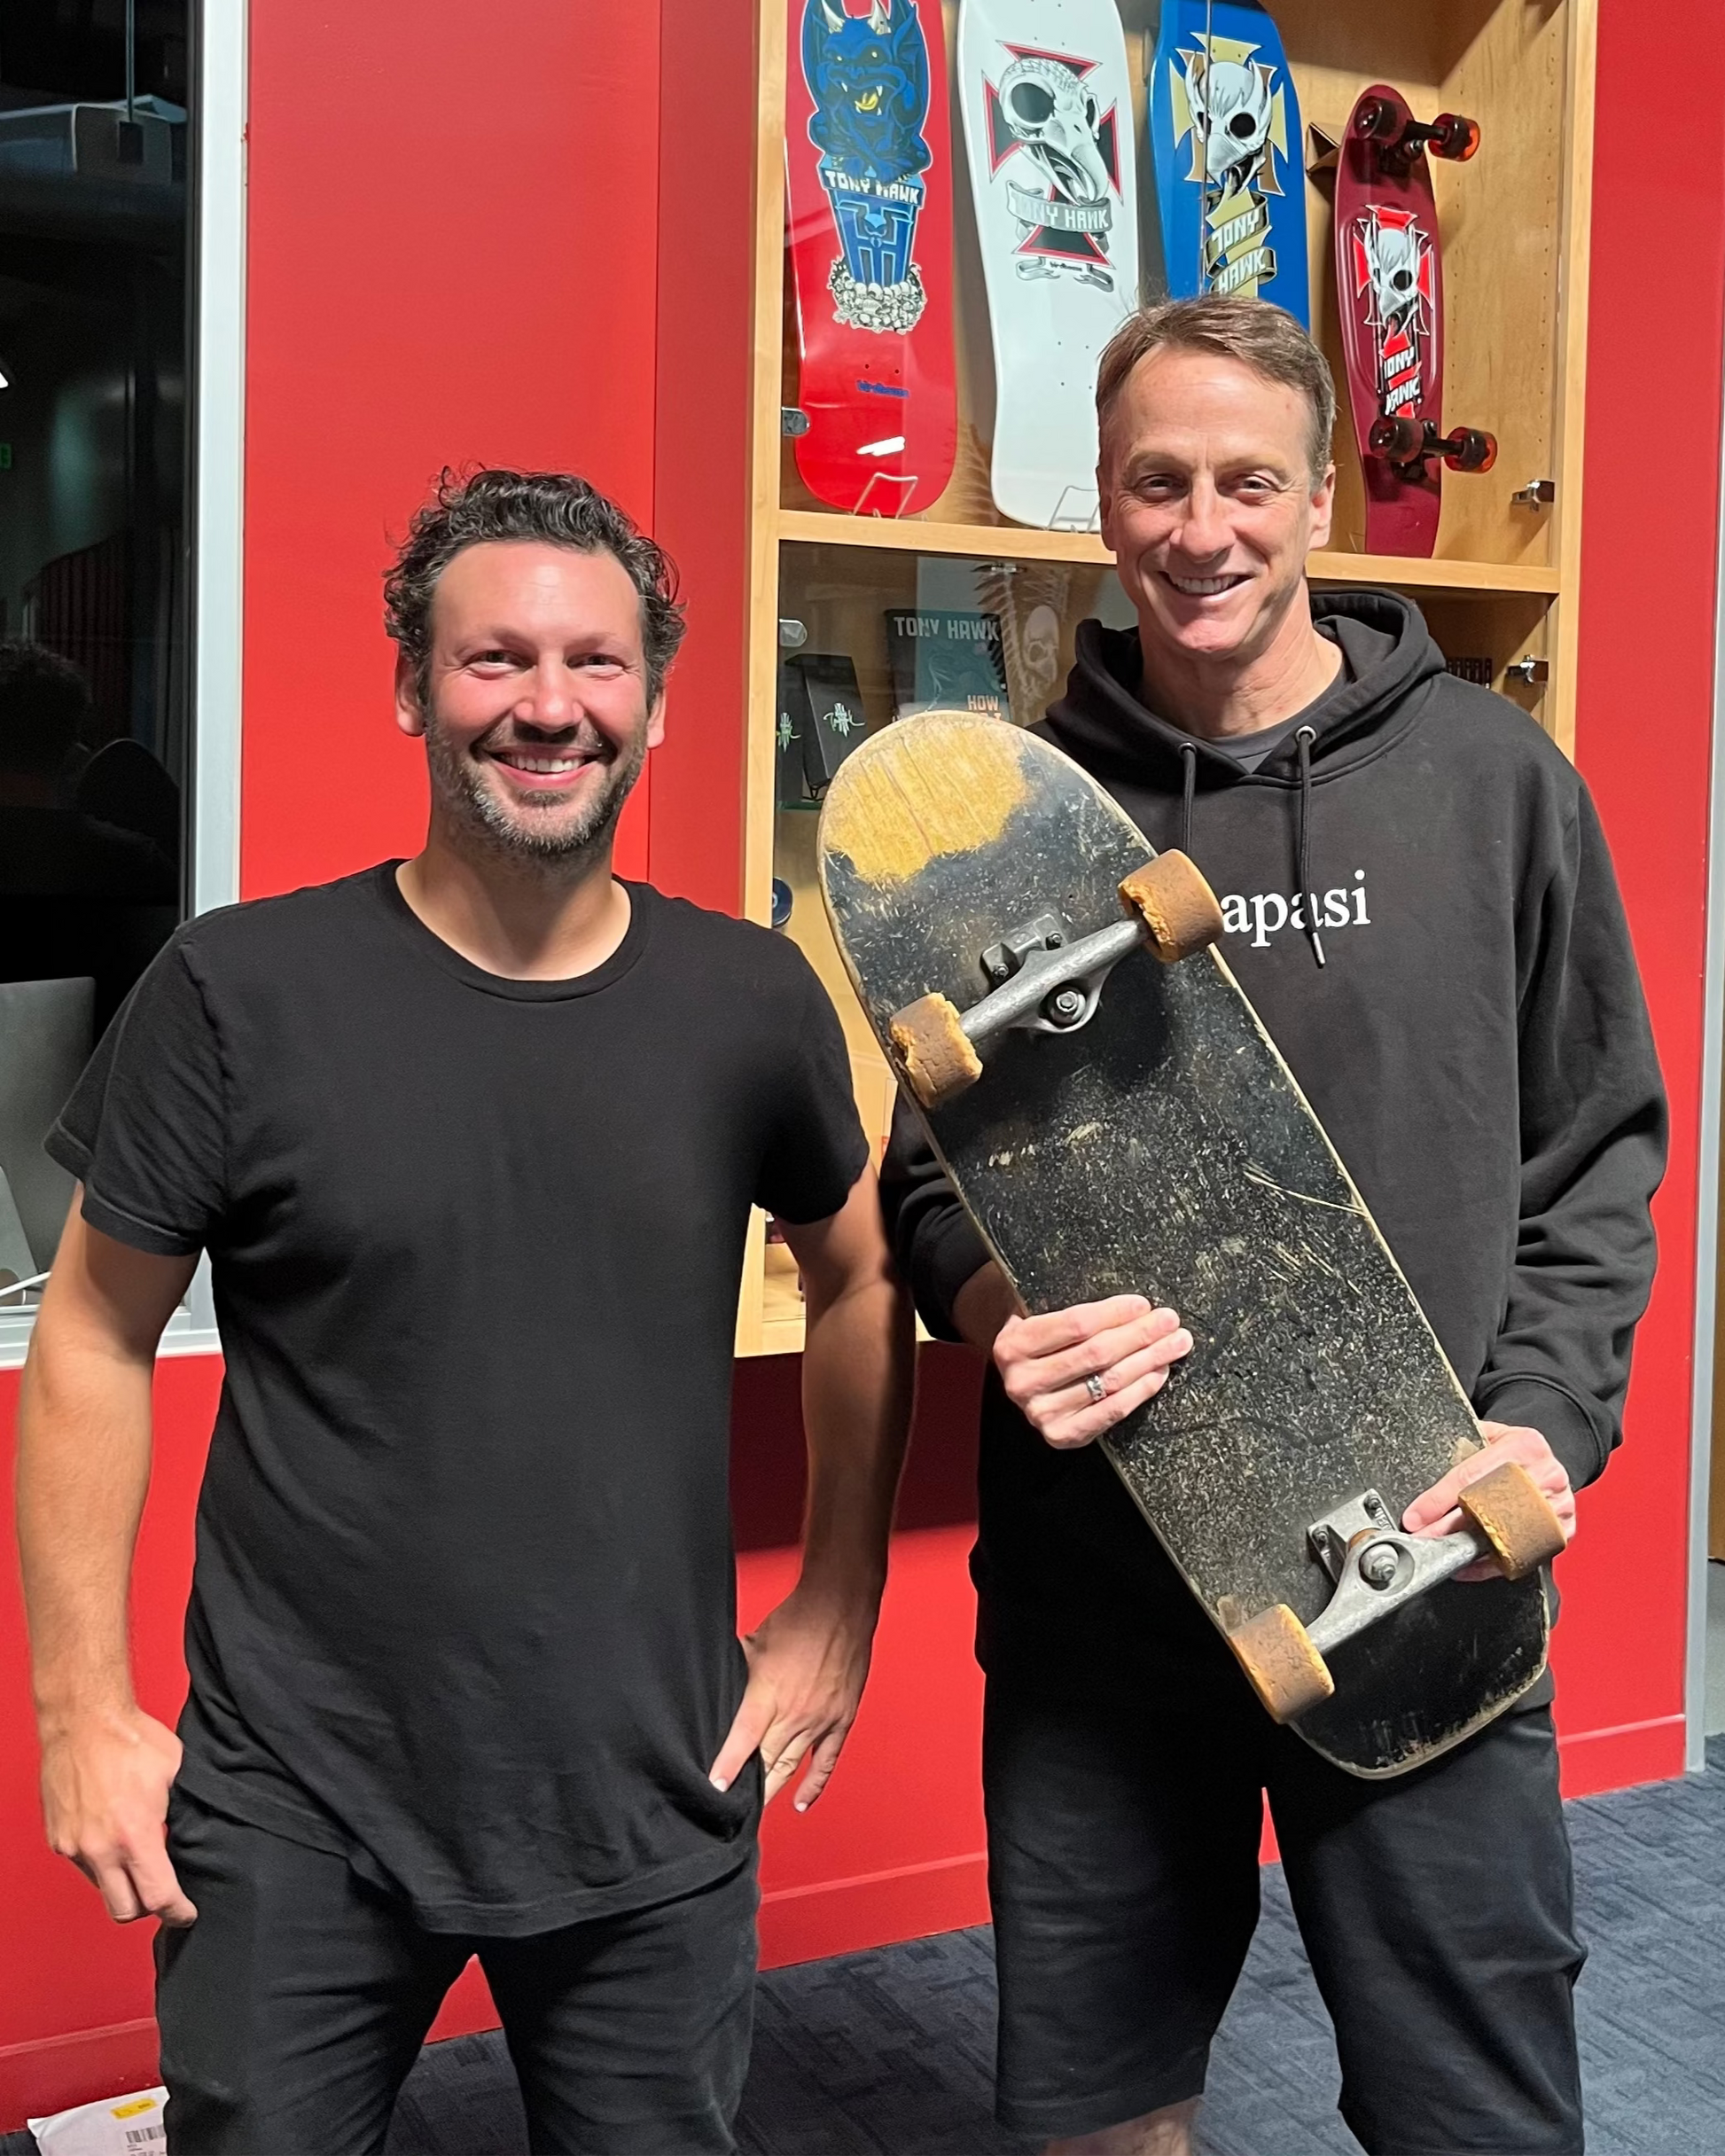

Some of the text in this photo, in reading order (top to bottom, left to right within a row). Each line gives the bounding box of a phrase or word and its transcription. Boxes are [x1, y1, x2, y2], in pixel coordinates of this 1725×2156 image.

[823, 169, 920, 205] TONY HAWK
[1064, 208, 1110, 230] HAWK
[1211, 207, 1260, 254] TONY
[1218, 248, 1267, 295] HAWK
[894, 617, 1000, 641] TONY HAWK
[967, 694, 999, 711] HOW
[1220, 869, 1371, 948] apasi
